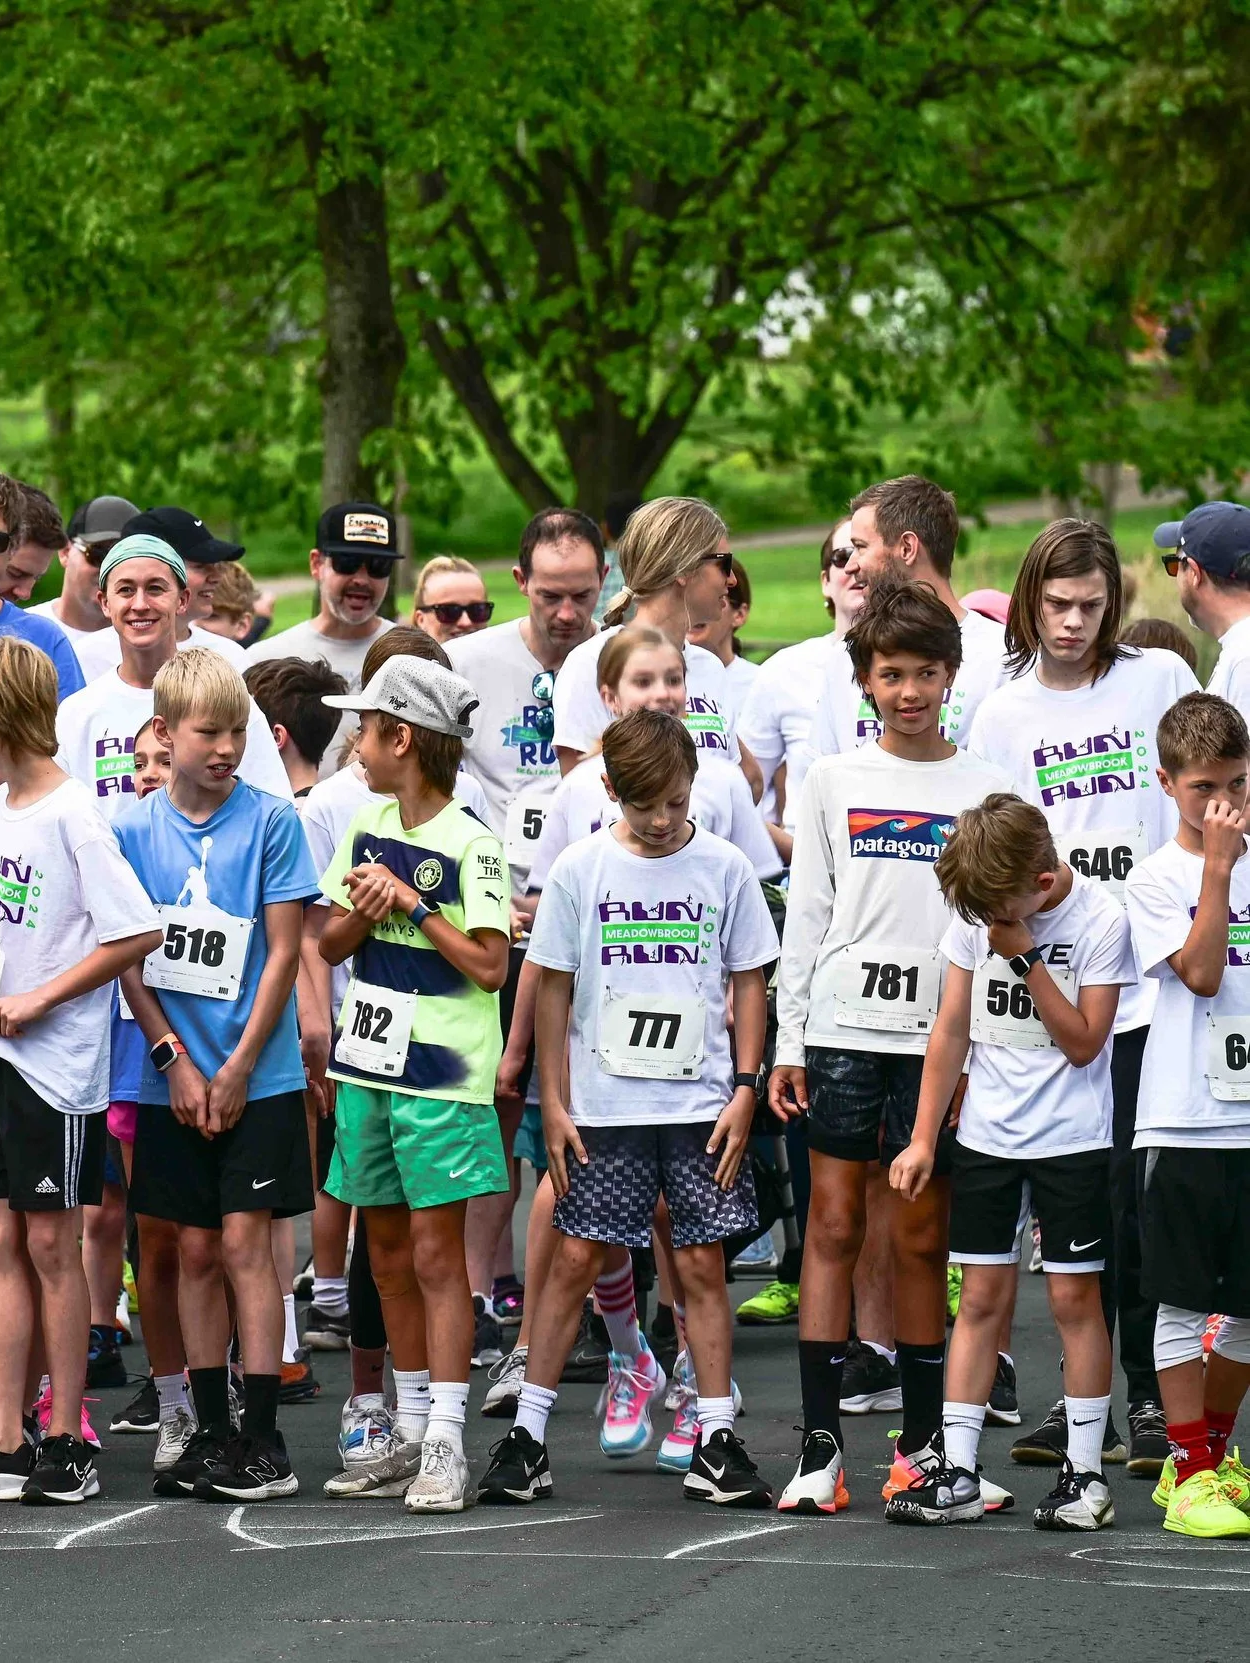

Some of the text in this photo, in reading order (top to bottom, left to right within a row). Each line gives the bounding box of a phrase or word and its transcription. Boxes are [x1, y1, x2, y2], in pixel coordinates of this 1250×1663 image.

[1033, 730, 1130, 767] RUN
[1134, 730, 1149, 789] 2024
[1044, 757, 1128, 780] MEADOWBROOK
[1041, 772, 1135, 806] RUN
[523, 808, 546, 840] 5
[1069, 846, 1134, 881] 646
[598, 901, 703, 922] RUN
[163, 923, 227, 967] 518
[605, 927, 697, 939] MEADOWBROOK
[700, 905, 718, 965] 2024
[601, 944, 699, 966] RUN
[861, 961, 919, 1002] 781
[986, 978, 1042, 1021] 56
[628, 1010, 682, 1050] 777
[1225, 1033, 1250, 1070] 6
[34, 1186, 60, 1194] adidas
